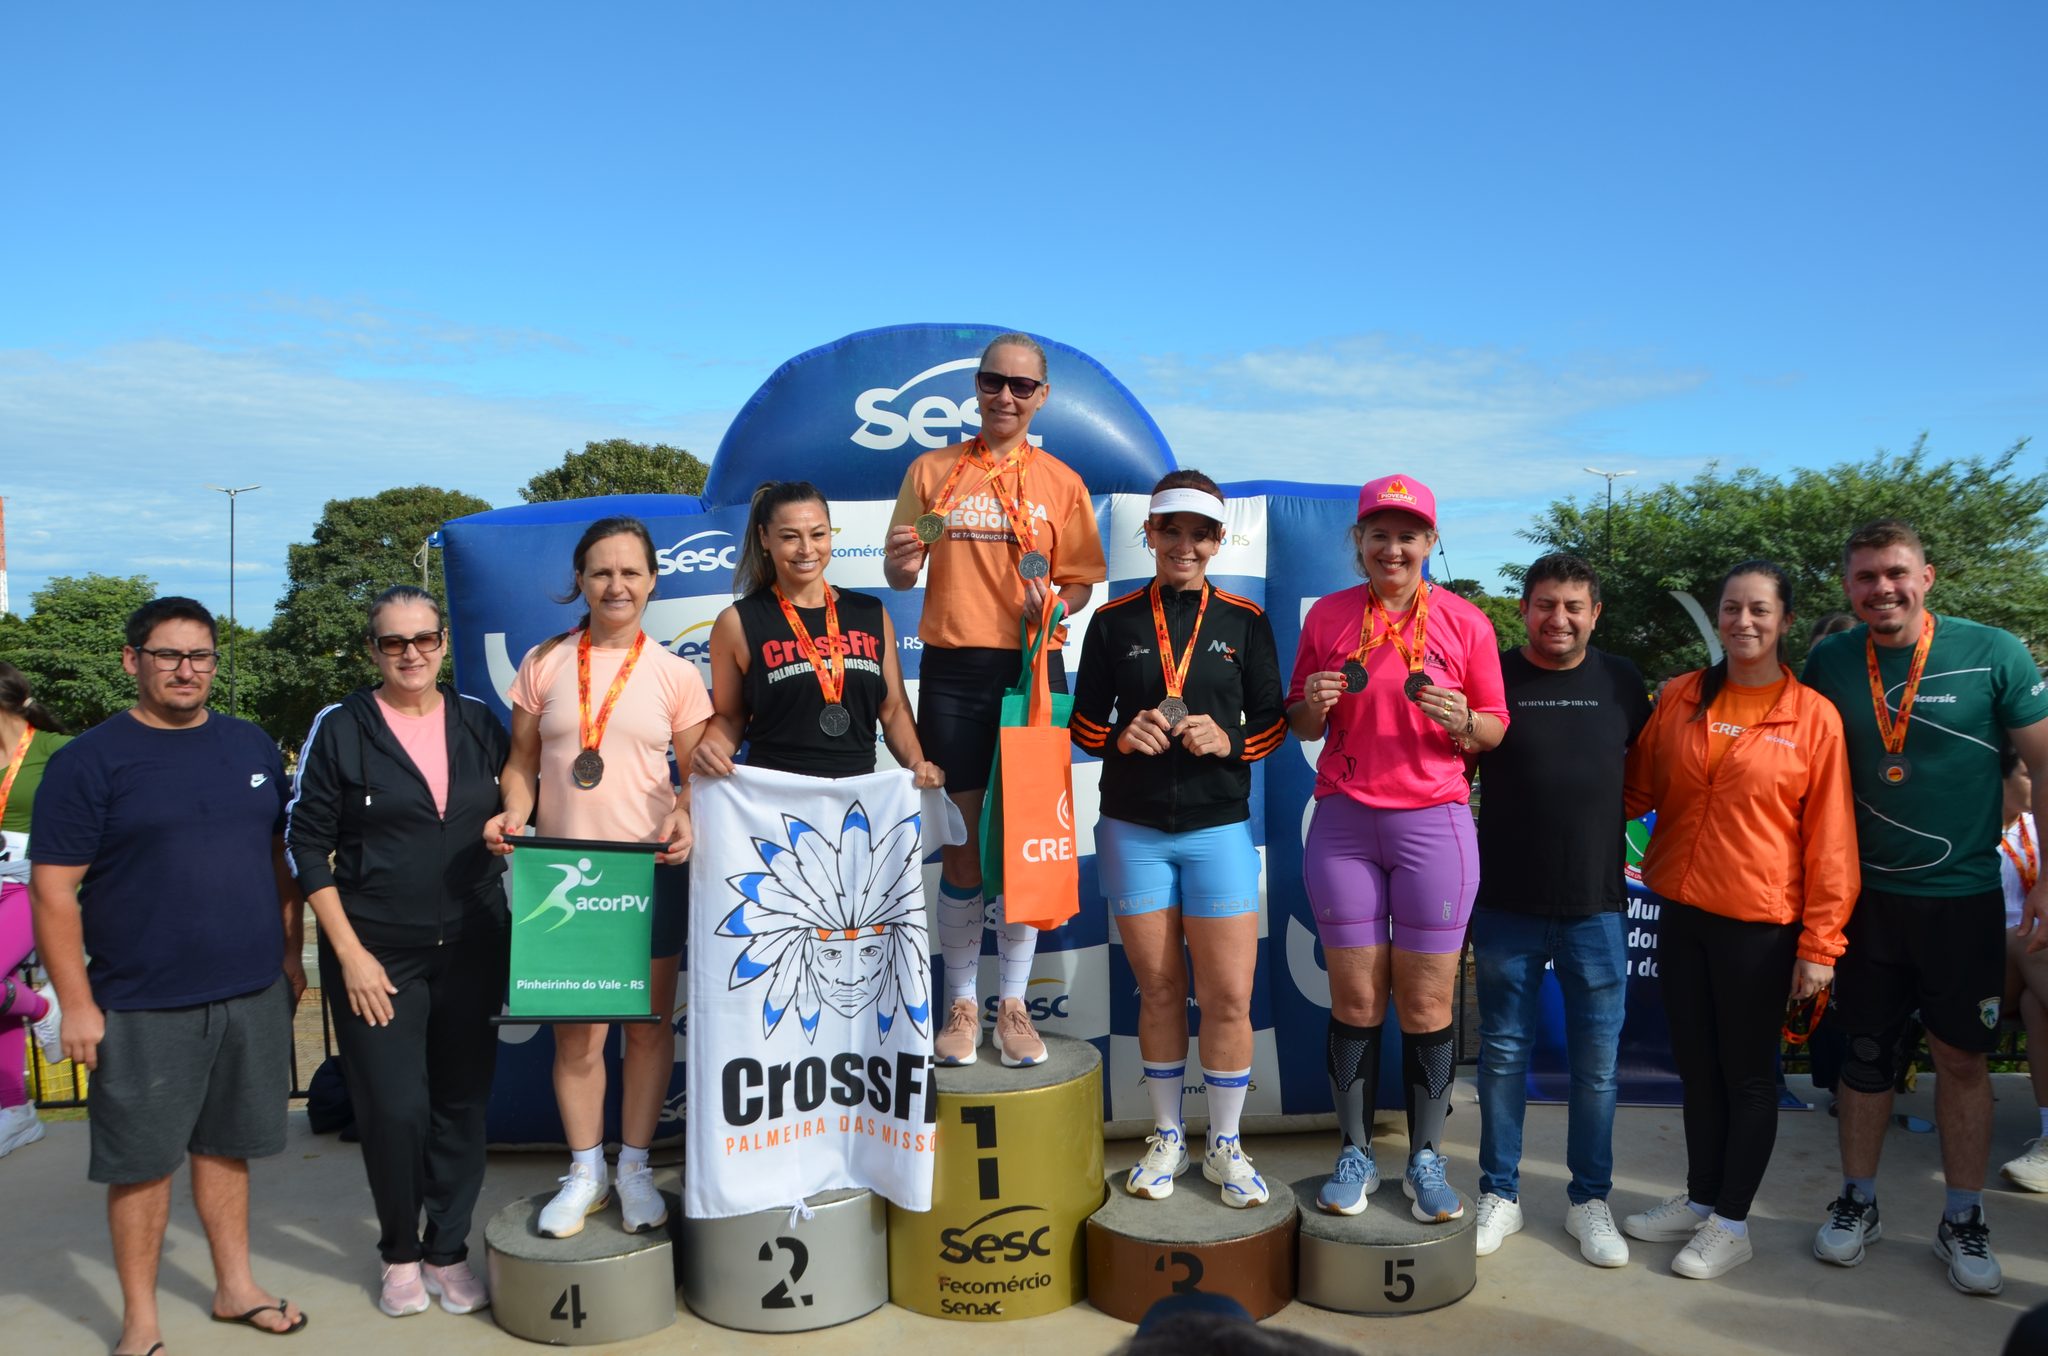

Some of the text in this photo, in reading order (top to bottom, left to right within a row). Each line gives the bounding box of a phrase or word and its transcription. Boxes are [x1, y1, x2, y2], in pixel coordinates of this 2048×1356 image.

[1231, 534, 1250, 546] RS
[904, 637, 923, 650] RS
[767, 661, 815, 685] PALMEIR
[844, 657, 881, 677] MISSÕES
[1710, 721, 1748, 737] CRE
[1022, 837, 1073, 863] CRE
[575, 895, 650, 913] acorPV
[516, 979, 581, 990] Pinheirinho
[582, 979, 596, 989] do
[598, 979, 621, 990] Vale
[630, 979, 645, 990] RS
[726, 1116, 826, 1156] PALMEIRA
[839, 1114, 876, 1137] DAS
[961, 1105, 1000, 1200] 1
[758, 1236, 814, 1309] 2
[939, 1272, 1052, 1295] Fecomércio
[1384, 1258, 1415, 1303] 5
[550, 1284, 588, 1329] 4
[941, 1299, 1004, 1316] Senac
